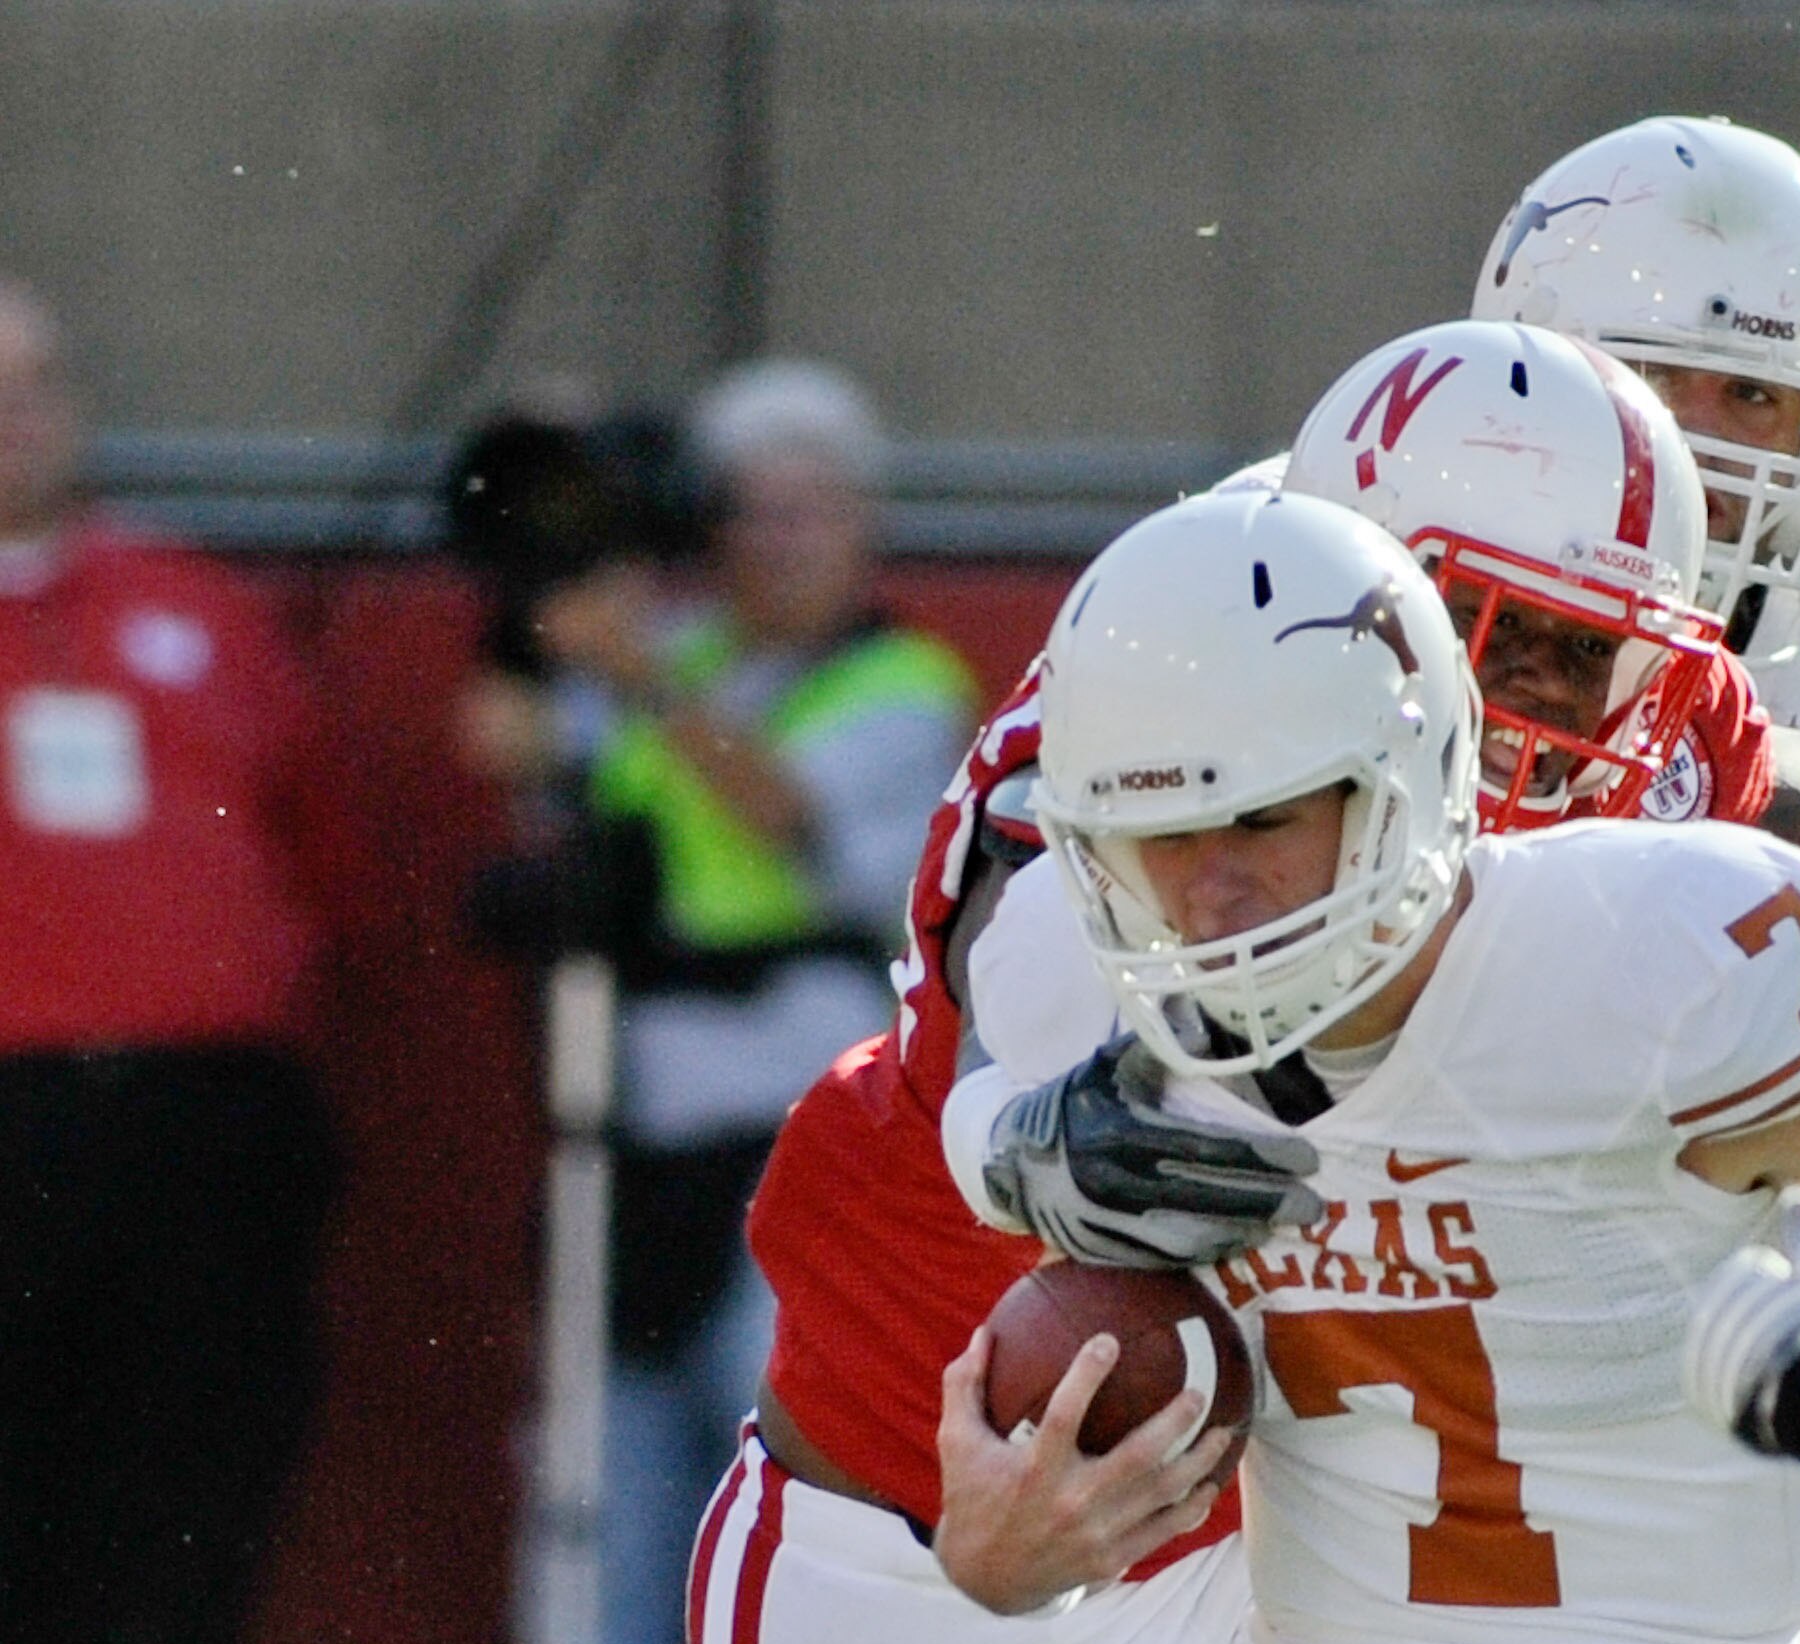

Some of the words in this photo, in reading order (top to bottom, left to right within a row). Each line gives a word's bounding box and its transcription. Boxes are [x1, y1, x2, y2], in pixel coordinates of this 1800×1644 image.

[1344, 348, 1464, 452] N
[1592, 546, 1655, 581] HUSKERS
[1118, 765, 1187, 792] HORNS
[1262, 1302, 1562, 1608] 7
